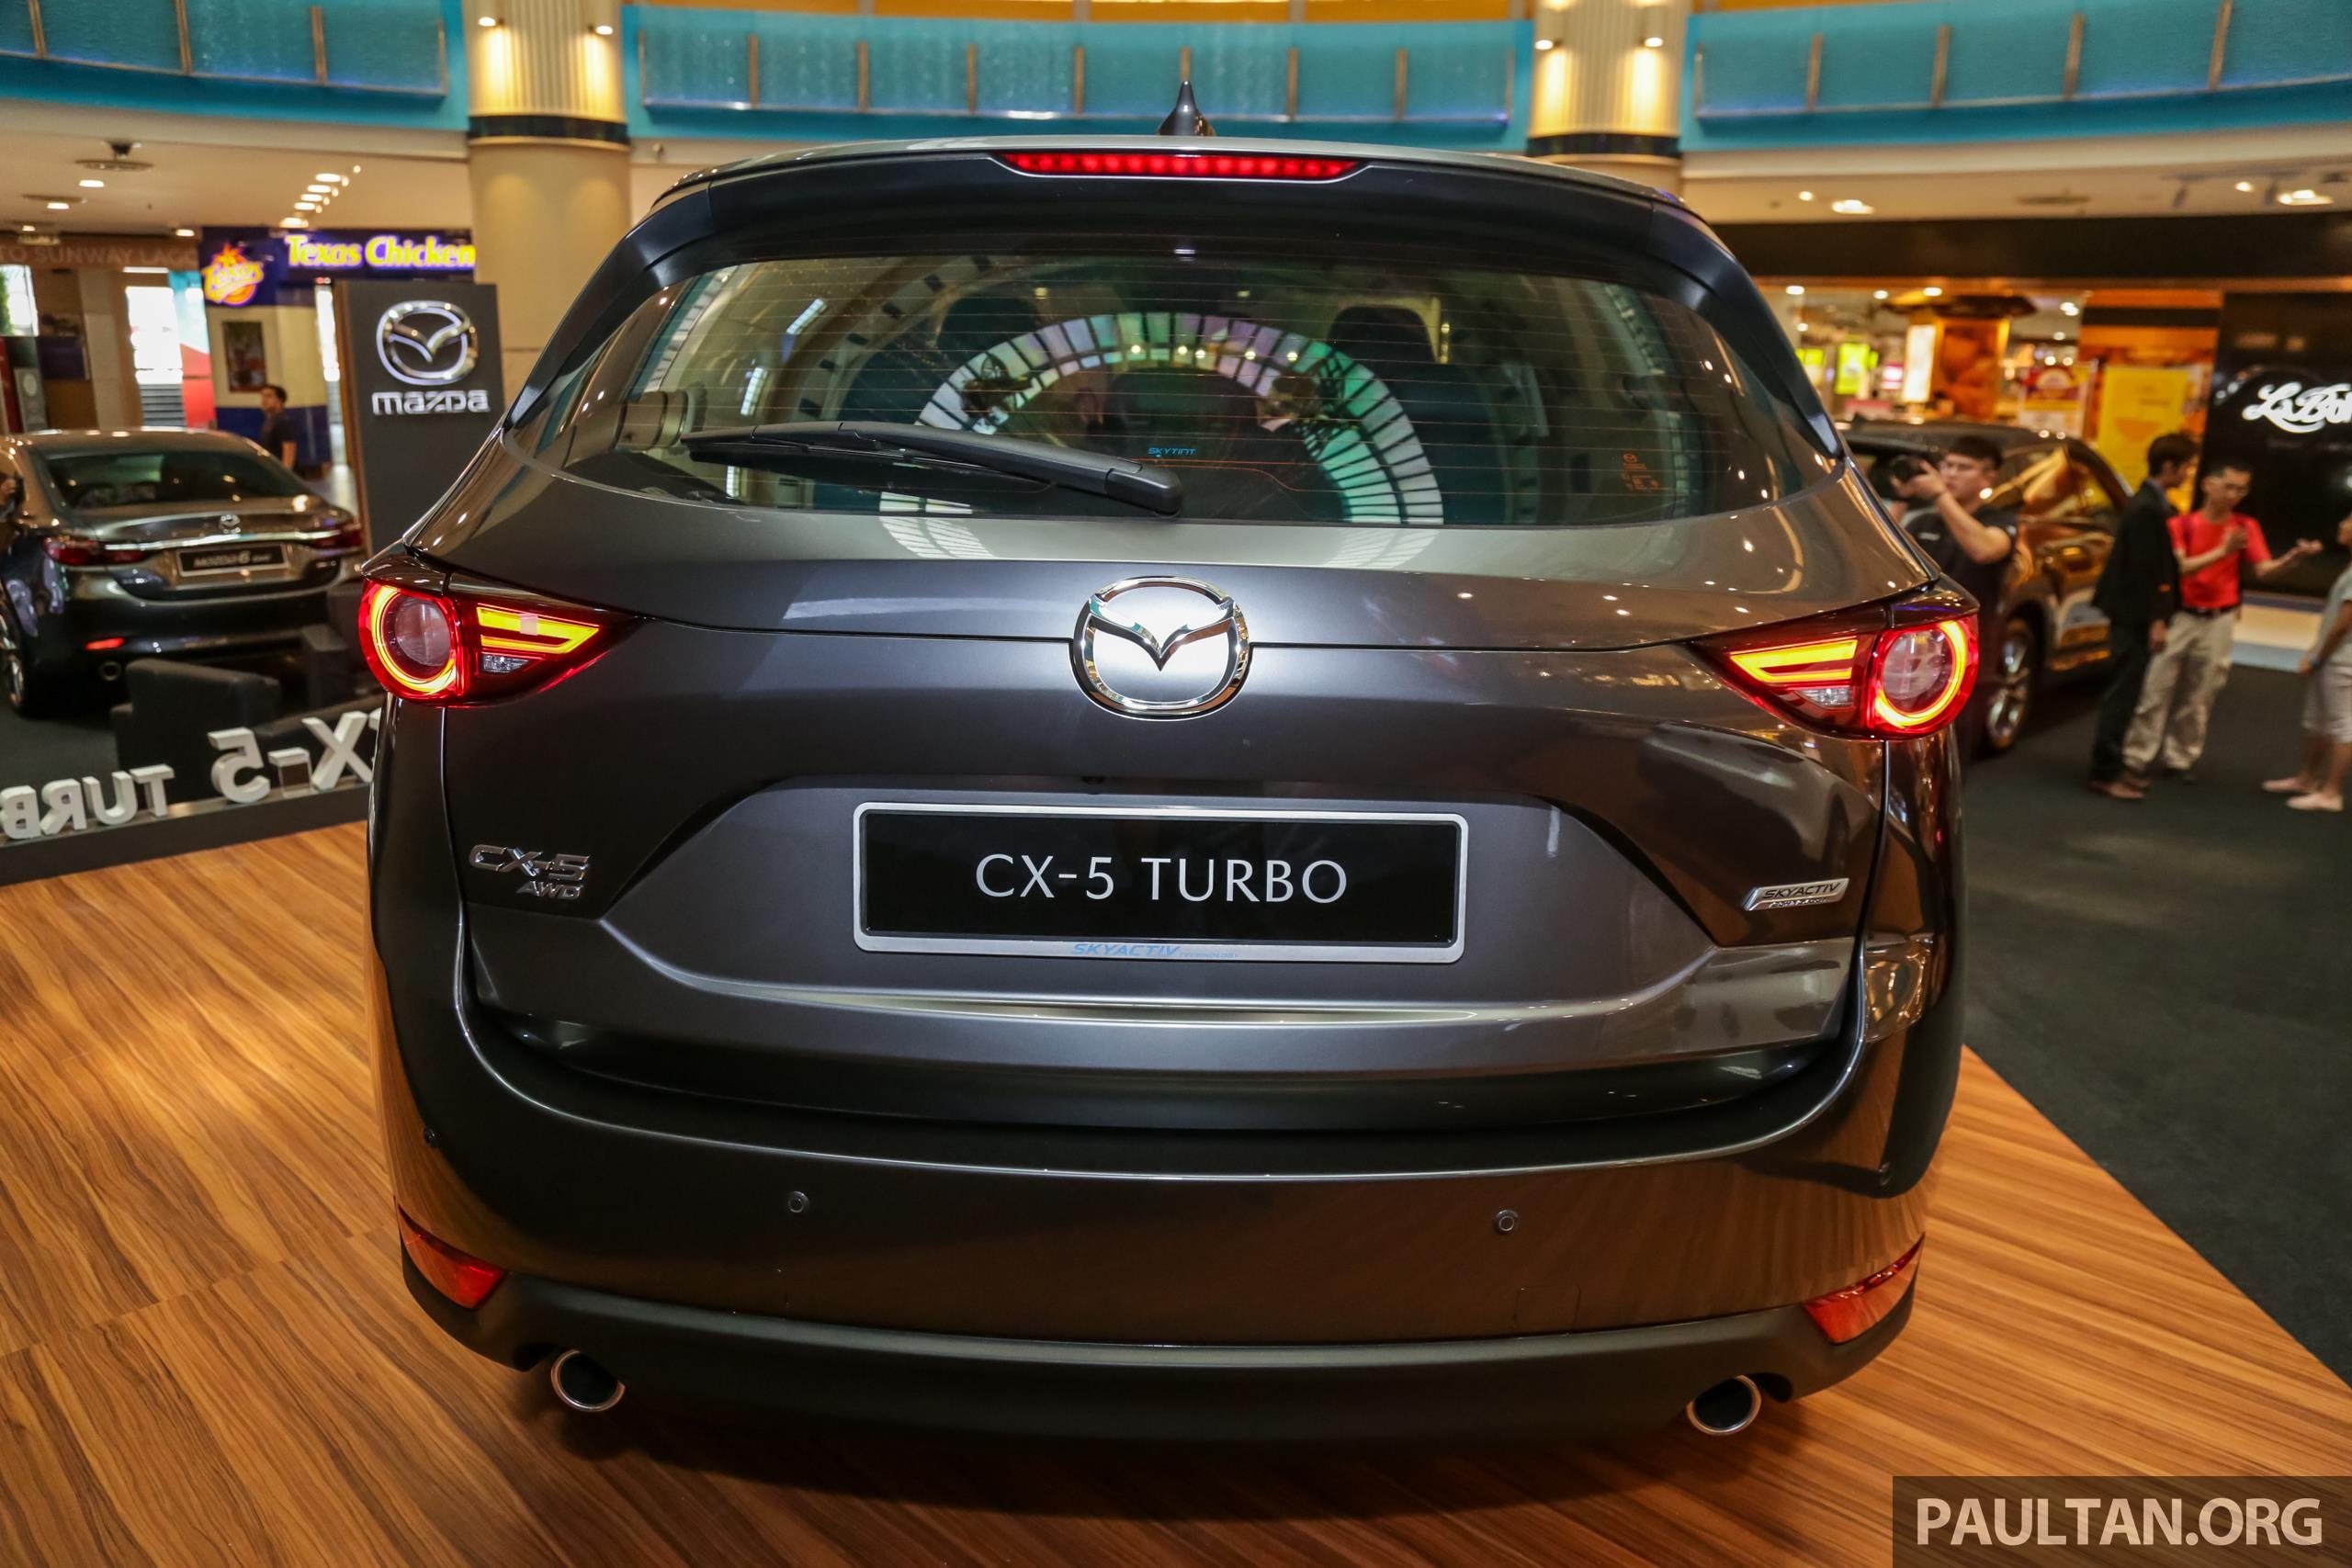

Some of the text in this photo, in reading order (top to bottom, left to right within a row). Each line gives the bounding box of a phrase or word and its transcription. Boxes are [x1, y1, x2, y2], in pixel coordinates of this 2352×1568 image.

[34, 247, 132, 265] SUNWAY
[285, 234, 476, 269] Texas Chicken
[469, 844, 590, 882] CX-5
[976, 853, 1348, 904] CX-5 TURBO
[515, 881, 583, 899] AWD
[1763, 883, 1840, 898] SKYACTIV
[1073, 943, 1181, 957] SKYACTIV
